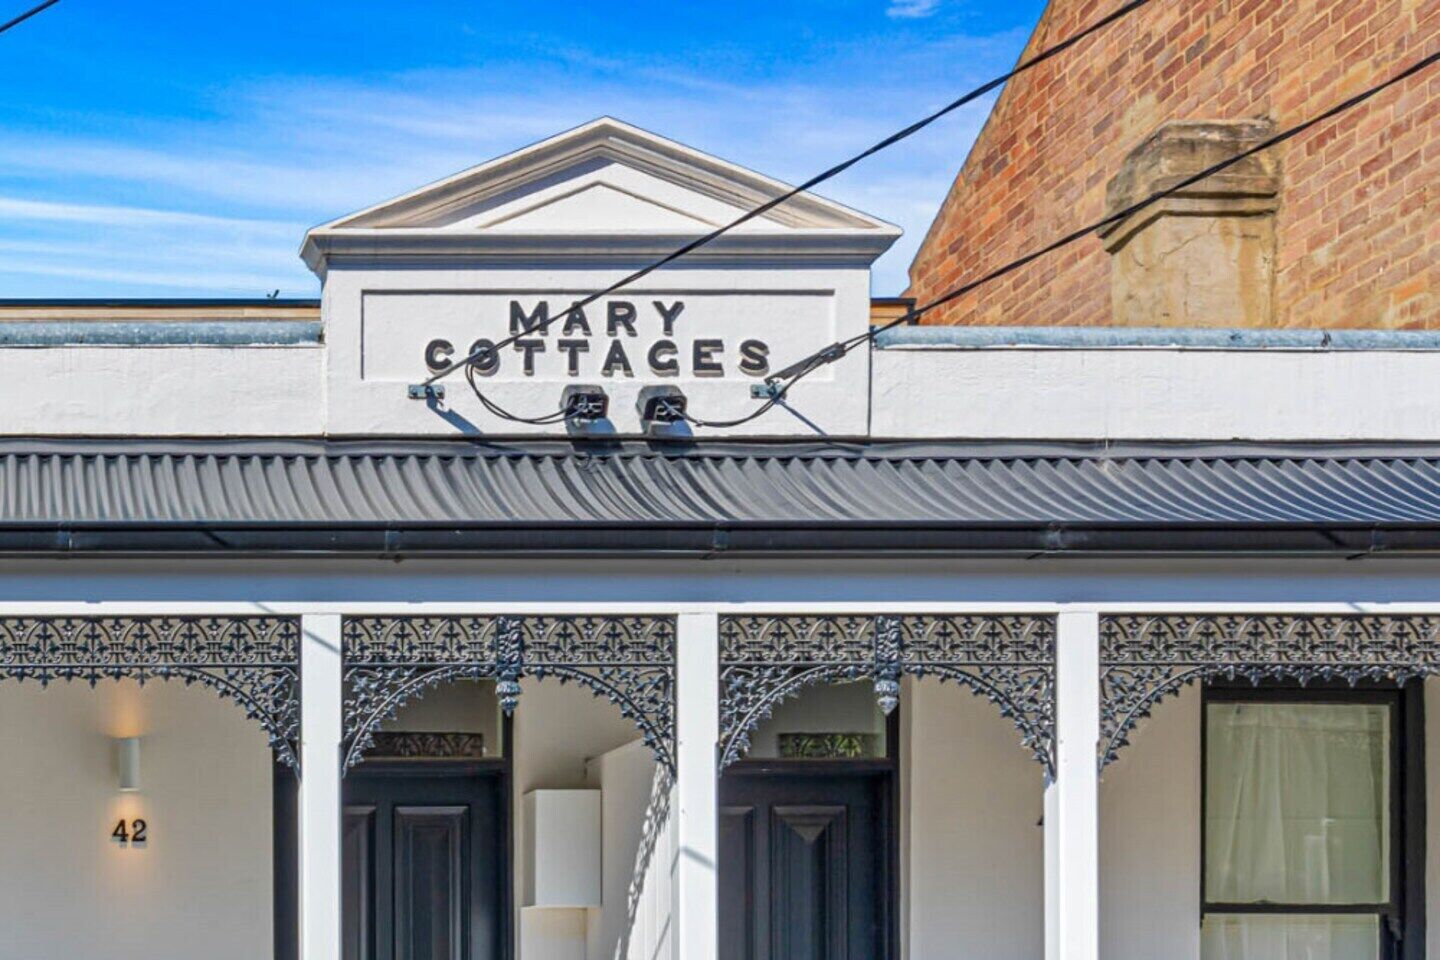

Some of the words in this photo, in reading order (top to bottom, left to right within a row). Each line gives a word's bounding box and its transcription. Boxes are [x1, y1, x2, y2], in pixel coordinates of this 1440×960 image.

[509, 300, 685, 337] MARY
[424, 338, 770, 377] COTTAGES
[112, 819, 147, 842] 42
